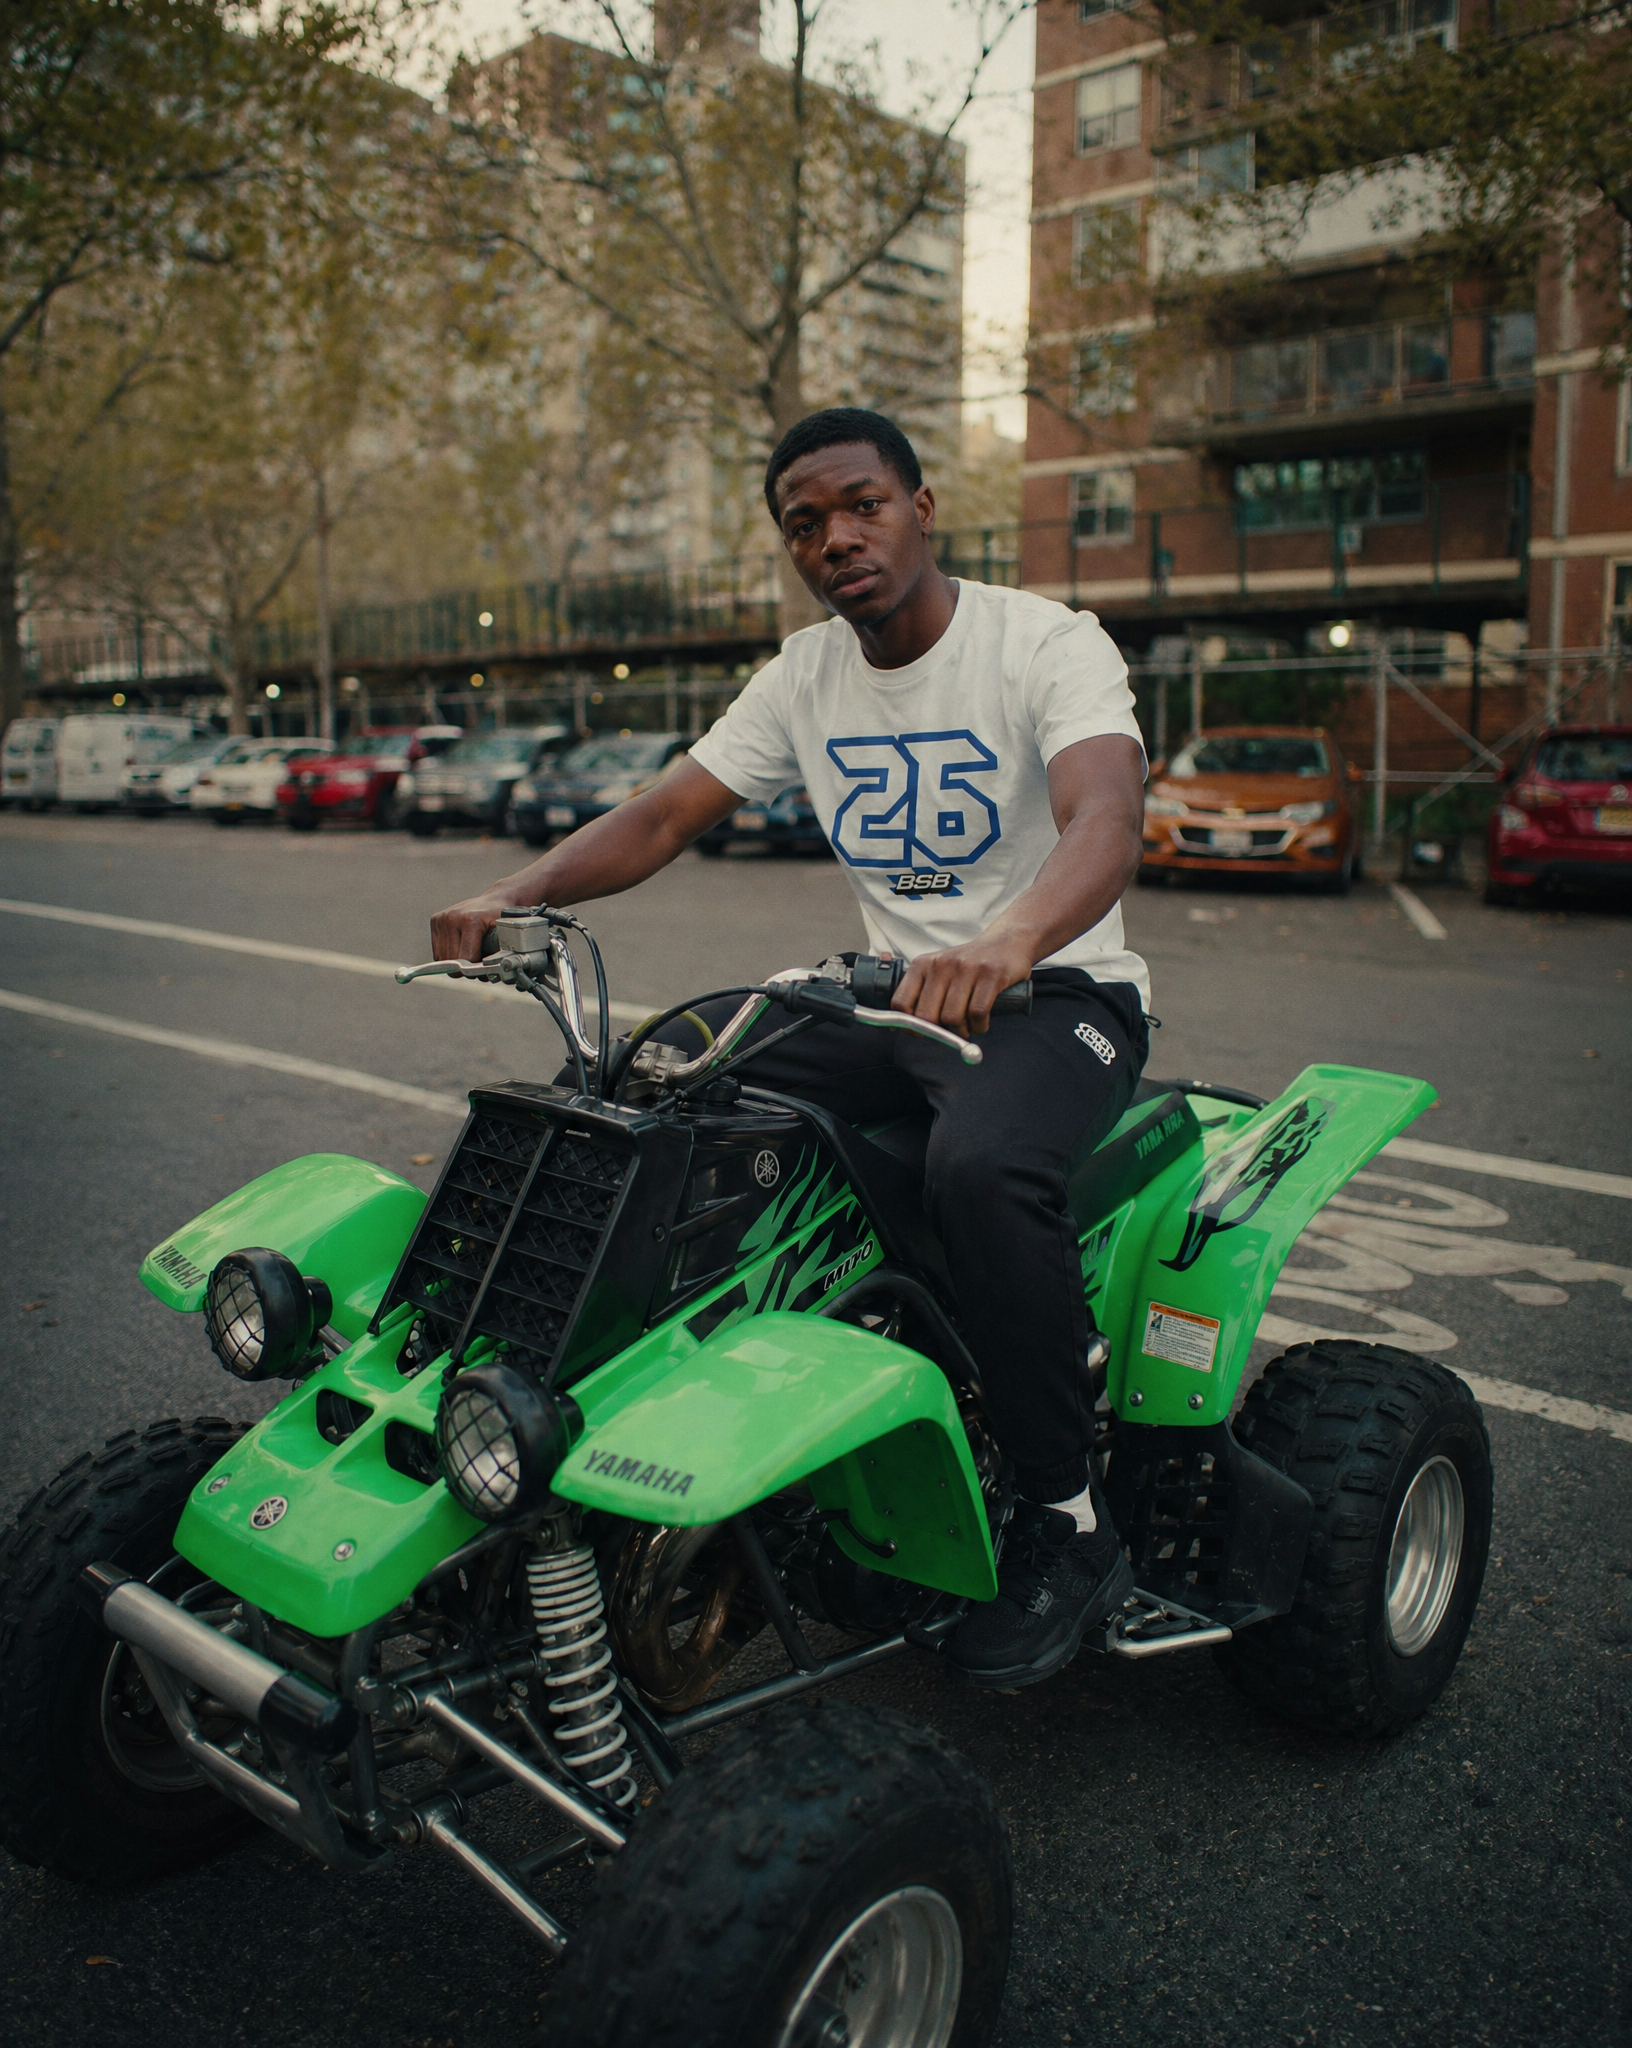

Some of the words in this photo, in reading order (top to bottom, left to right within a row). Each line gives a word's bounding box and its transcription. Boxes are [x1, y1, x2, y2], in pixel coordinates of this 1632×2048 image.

[826, 728, 1002, 869] 26
[896, 872, 952, 891] BSB
[152, 1245, 208, 1290] YAMAHA
[583, 1449, 695, 1496] YAMAHA
